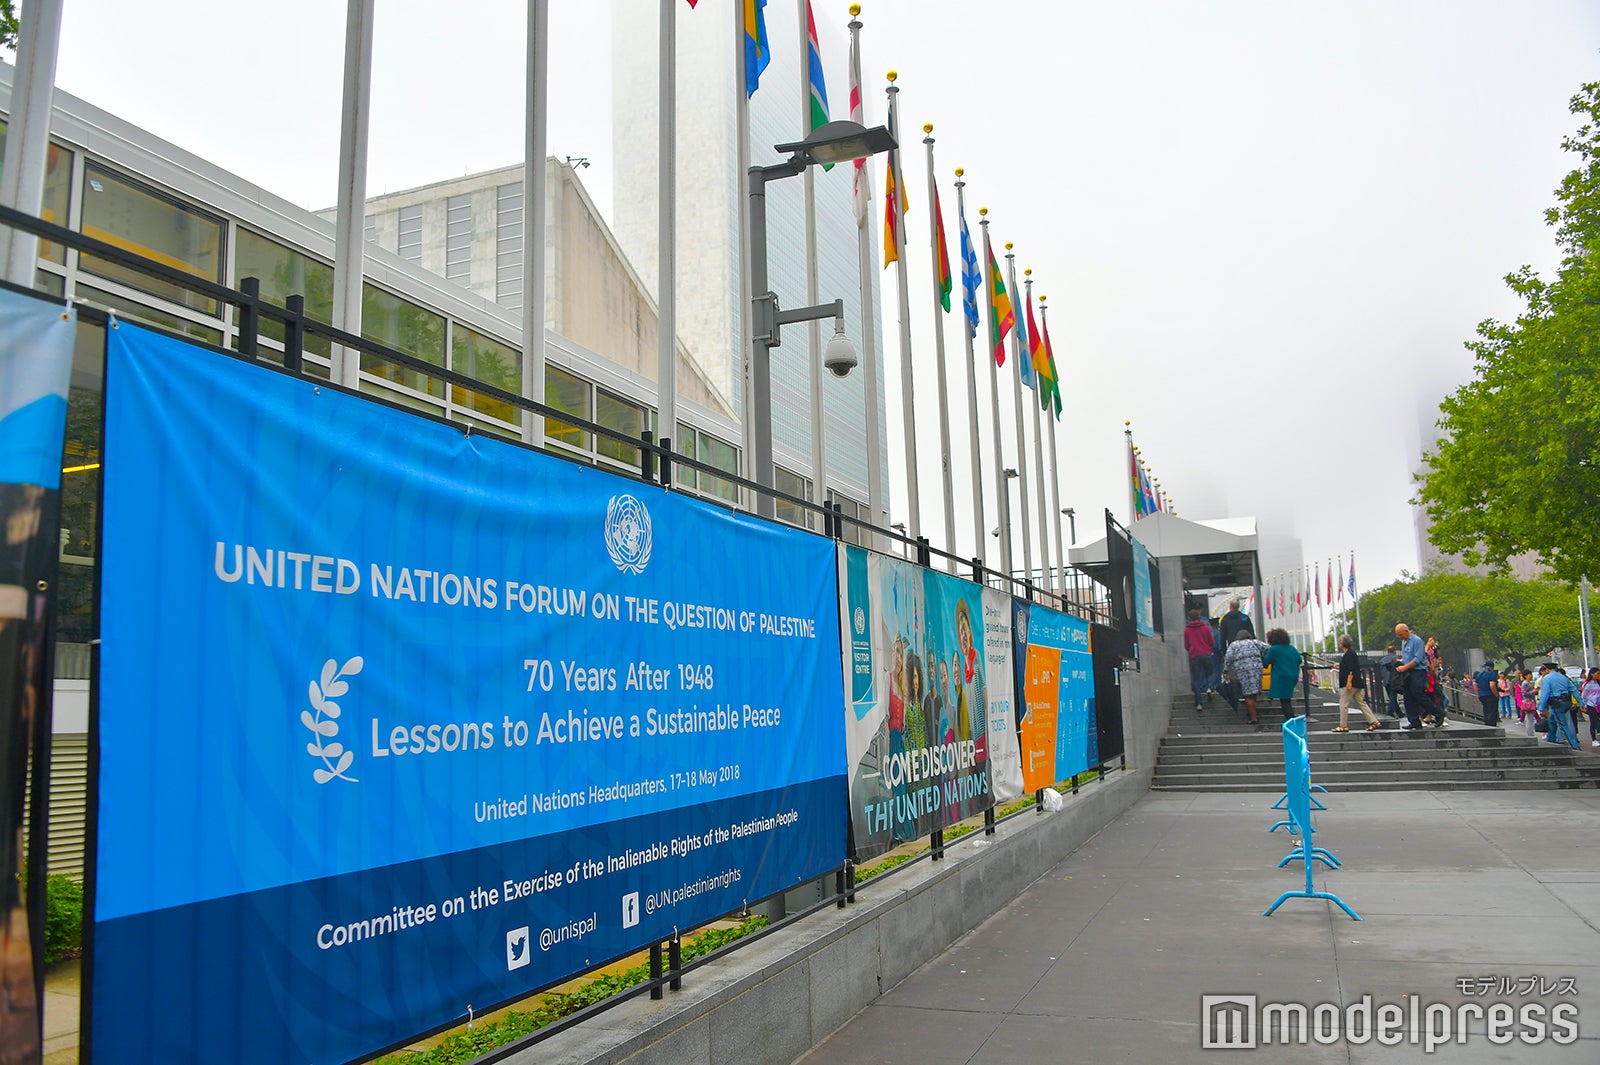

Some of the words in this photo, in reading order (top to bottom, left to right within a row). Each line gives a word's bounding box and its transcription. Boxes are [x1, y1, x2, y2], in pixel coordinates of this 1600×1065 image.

[214, 541, 361, 595] UNITED
[370, 563, 498, 609] NATIONS
[505, 581, 586, 618] FORUM
[591, 592, 620, 621] ON
[624, 595, 659, 624] THE
[663, 601, 736, 631] QUESTION
[739, 611, 756, 633] OF
[759, 613, 816, 639] PALESTINE
[523, 659, 554, 692] 70
[560, 660, 617, 692] Years
[625, 661, 671, 691] After
[678, 663, 714, 691] 1948
[372, 717, 495, 757] Lessons
[502, 715, 529, 748] to
[536, 708, 624, 745] Achieve
[629, 715, 641, 737] a
[646, 704, 739, 736] Sustainable
[742, 704, 781, 729] Peace
[883, 748, 920, 790] COME
[922, 739, 976, 779] DISCOVER
[474, 794, 528, 823] United
[532, 789, 585, 814] Nations
[588, 778, 668, 804] Headquarters,
[669, 769, 697, 790] 17-18
[698, 769, 718, 787] May
[719, 764, 741, 781] 2018
[896, 785, 941, 824] UNTED
[944, 771, 989, 807] NATIONS
[316, 903, 437, 950] Committee
[441, 895, 465, 919] on
[469, 886, 499, 911] the
[503, 869, 563, 902] Exercise
[566, 861, 580, 883] of
[582, 859, 604, 880] the
[607, 841, 668, 873] Inalienable
[671, 835, 702, 859] Rights
[703, 828, 714, 846] of
[714, 826, 730, 843] the
[731, 817, 776, 840] Palestinian
[645, 867, 742, 915] @UN.palestinianrights
[539, 912, 598, 952] @unispal
